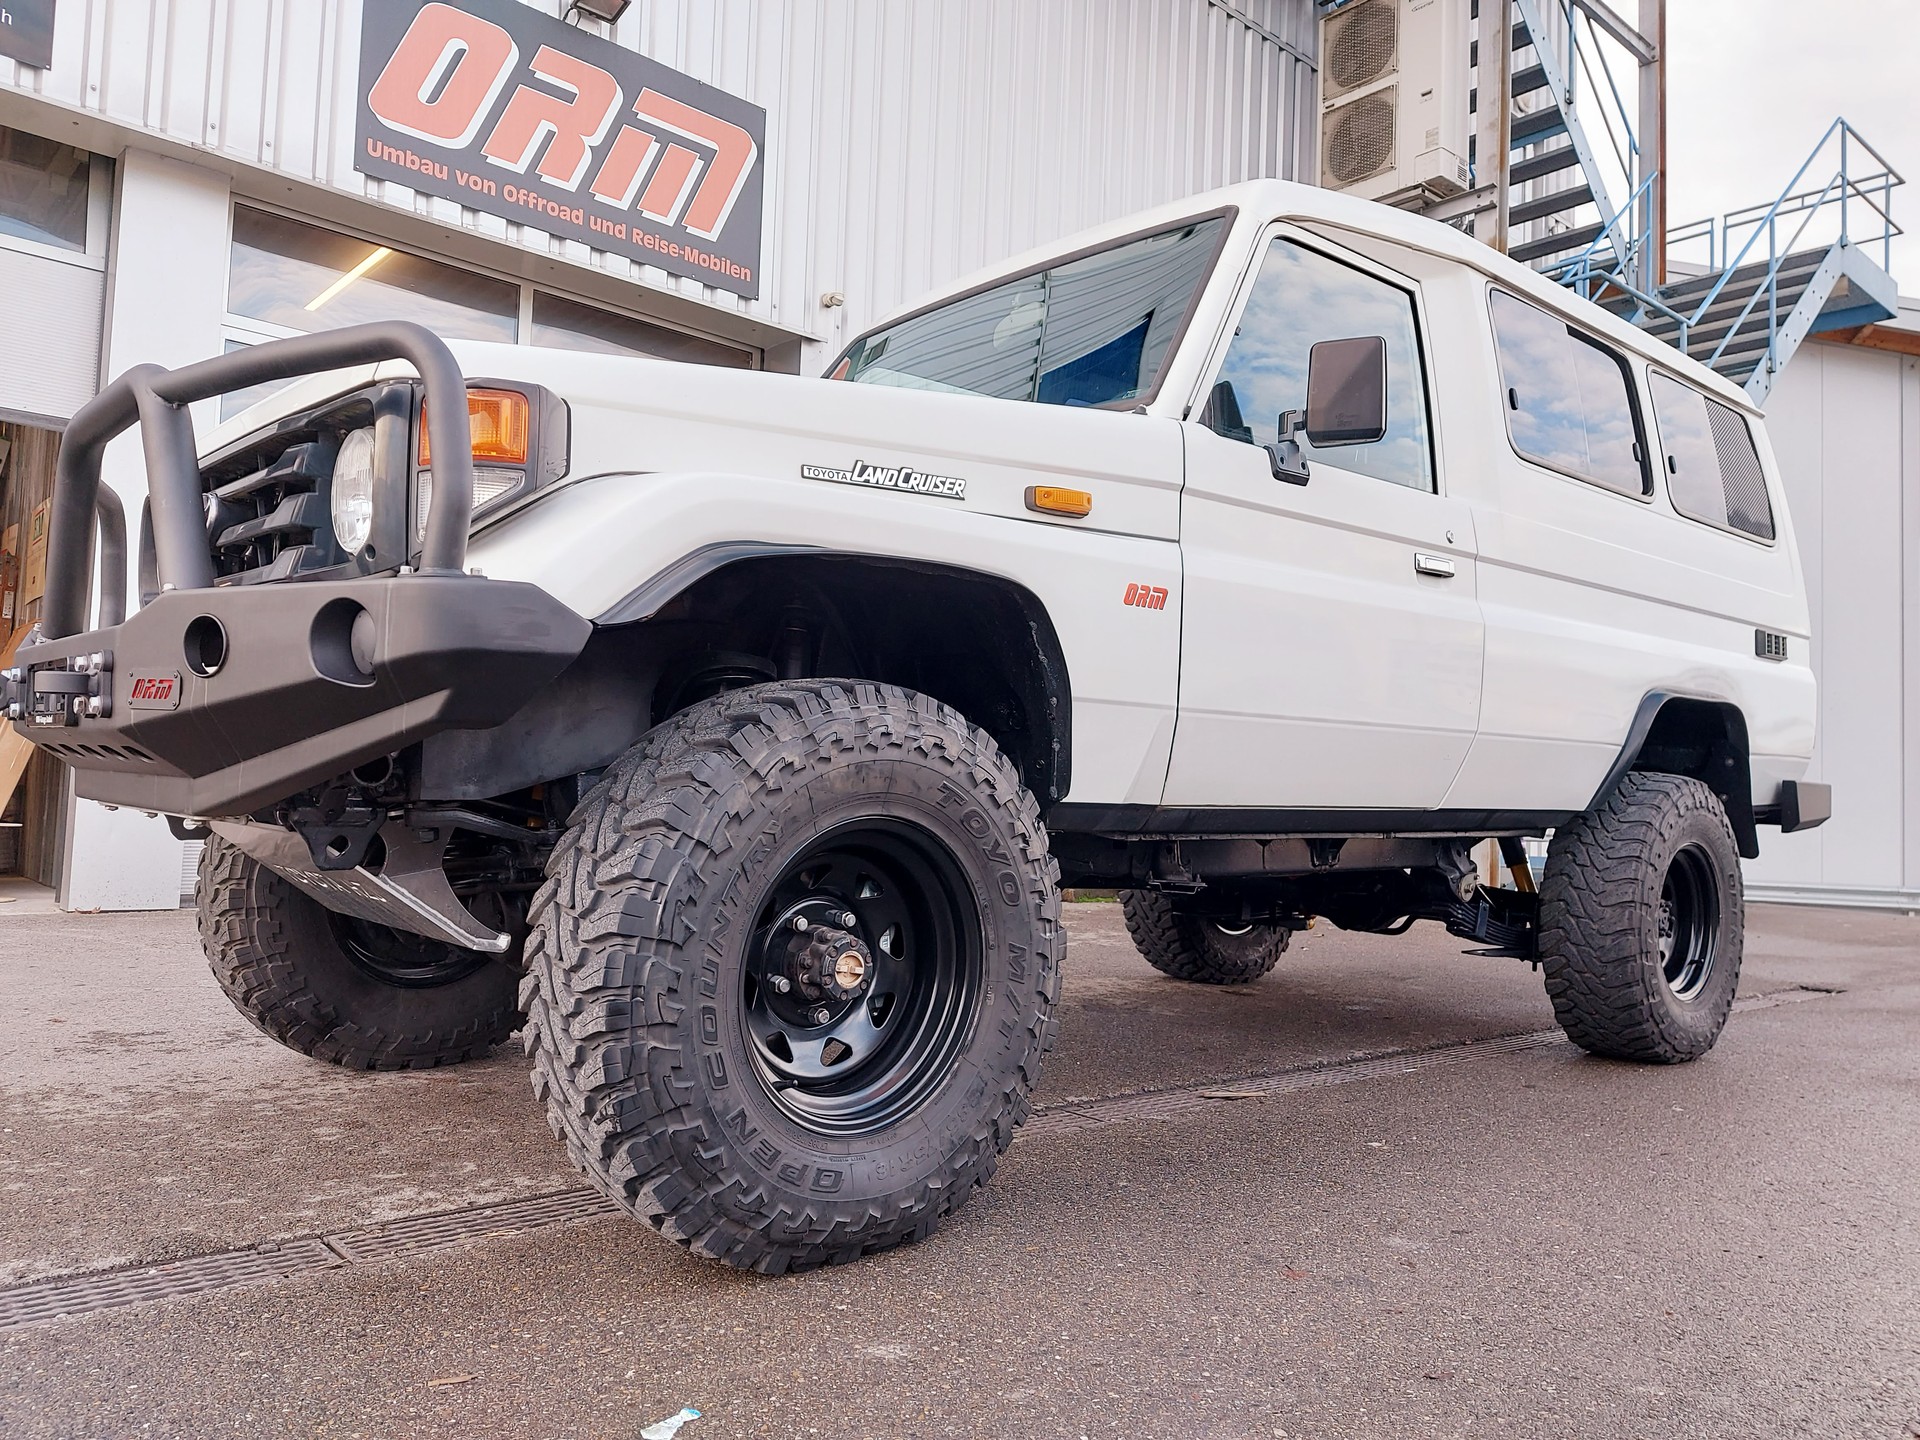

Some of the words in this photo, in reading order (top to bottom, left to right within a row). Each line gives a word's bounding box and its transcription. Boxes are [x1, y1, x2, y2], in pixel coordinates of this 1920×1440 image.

[368, 2, 758, 242] ORM
[367, 136, 448, 180] Umbau
[456, 171, 496, 197] von
[503, 183, 584, 225] Offroad
[589, 211, 627, 241] und
[632, 227, 751, 282] Reise-Mobilen
[806, 467, 848, 481] TOYOTA
[1123, 582, 1168, 610] ORM
[131, 678, 174, 700] ORM
[935, 780, 1023, 906] TOYO
[701, 802, 792, 1091] COUNTRY
[726, 1107, 846, 1194] OPEN
